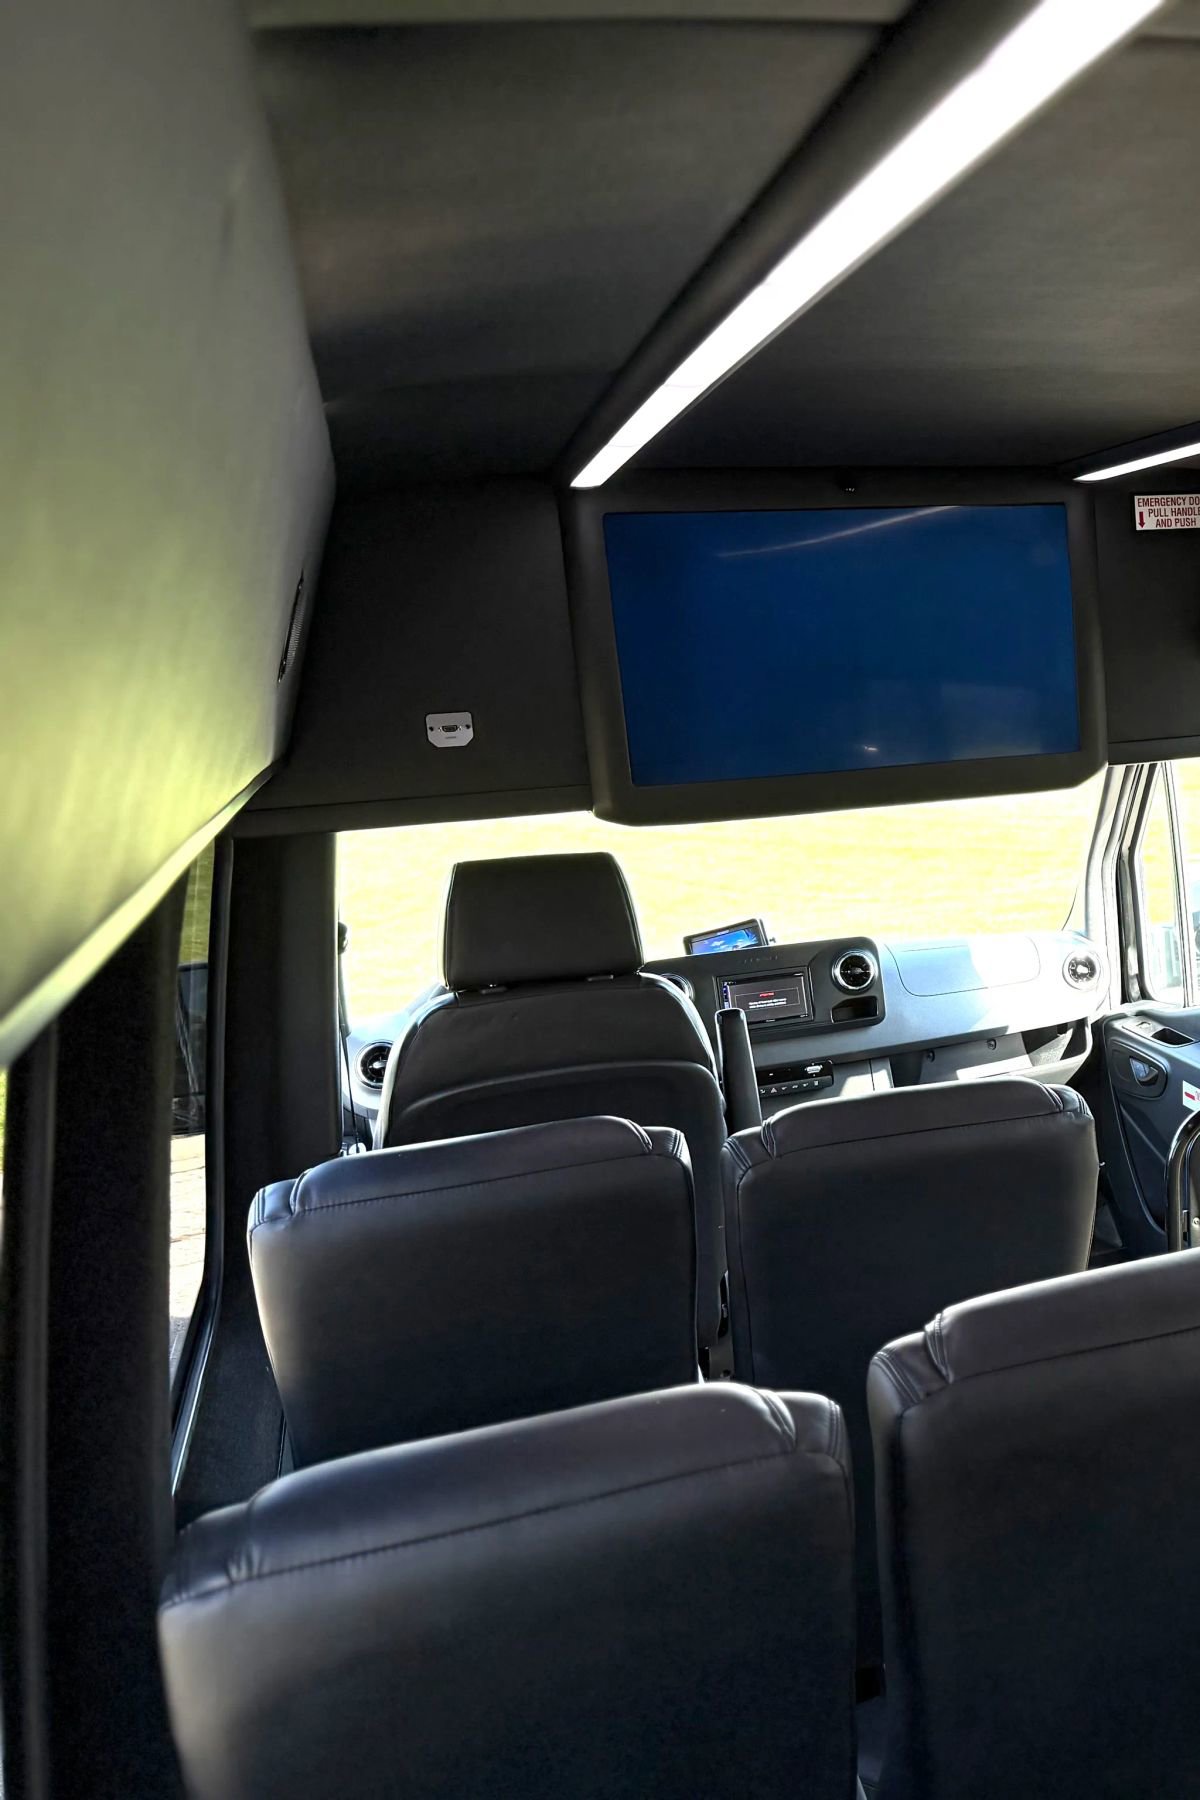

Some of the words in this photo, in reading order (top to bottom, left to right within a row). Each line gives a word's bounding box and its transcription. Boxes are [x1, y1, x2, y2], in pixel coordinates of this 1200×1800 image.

[1137, 496, 1187, 507] EMERGENCY
[1148, 508, 1169, 517] PULL
[1156, 518, 1172, 528] AND
[1175, 518, 1196, 527] PUSH
